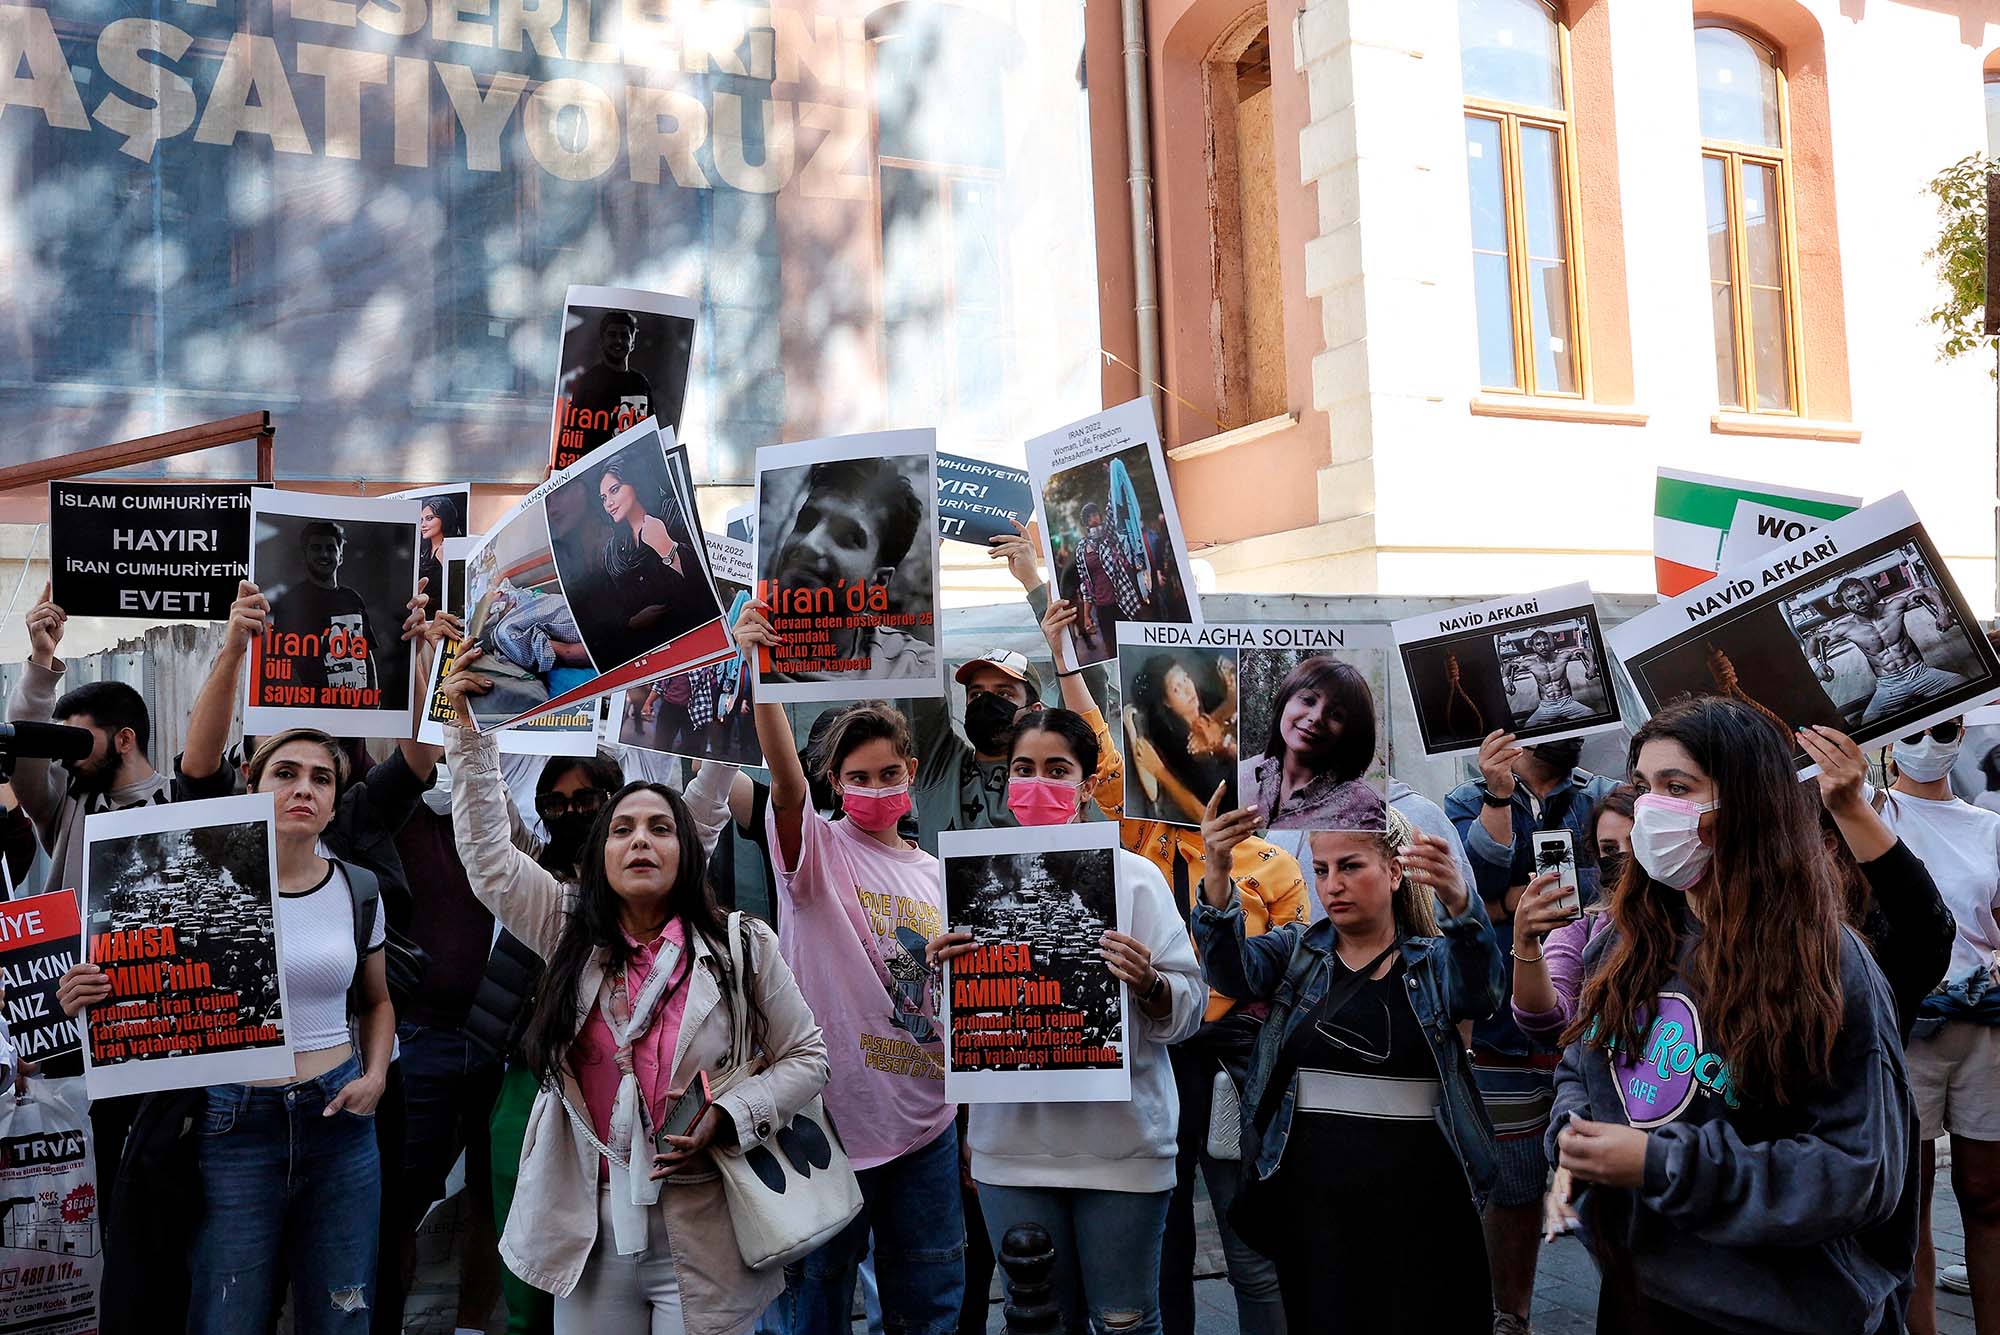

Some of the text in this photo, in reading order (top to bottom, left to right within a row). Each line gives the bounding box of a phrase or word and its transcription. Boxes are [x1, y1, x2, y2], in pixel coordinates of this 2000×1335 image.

[561, 428, 585, 449] ölü
[1068, 421, 1102, 441] IRAN 2022
[1092, 426, 1122, 441] Freedom
[1051, 447, 1094, 468] #MahsaAmini
[936, 458, 1031, 485] MHURİYETİN
[59, 490, 116, 509] İSLAM
[113, 528, 218, 552] HAYIR!
[724, 544, 745, 558] 2022
[66, 556, 110, 575] İRAN
[712, 551, 728, 564] Life,
[1685, 534, 1839, 622] NAVİD AFKARİ
[119, 589, 210, 613] EVET!
[774, 616, 812, 630] devam
[815, 615, 843, 629] eden
[846, 612, 916, 630] gösterilerde
[1439, 597, 1540, 633] NAVİD AFKARİ
[1144, 627, 1345, 648] NEDA AGHA SOLTAN
[811, 643, 837, 657] ZARE
[265, 657, 292, 680] ölü
[776, 656, 872, 673] hayatını kaybetti
[264, 684, 382, 708] sayısı artıyor
[0, 910, 45, 942] İYE
[89, 925, 177, 964] MAHSA
[953, 944, 1032, 975] MAHSA
[953, 975, 1062, 1008] AMINI'nin
[7, 992, 50, 1026] NIZ
[91, 1000, 158, 1024] ardından
[195, 991, 239, 1012] rejimi
[92, 1011, 238, 1041] tarafından yüzlerce
[954, 1011, 1012, 1031] ardından
[1045, 1011, 1085, 1029] rejimi
[860, 1033, 907, 1058] FASHION
[954, 1029, 1082, 1049] tarafından yüzlerce
[1628, 1077, 1658, 1105] CAFE
